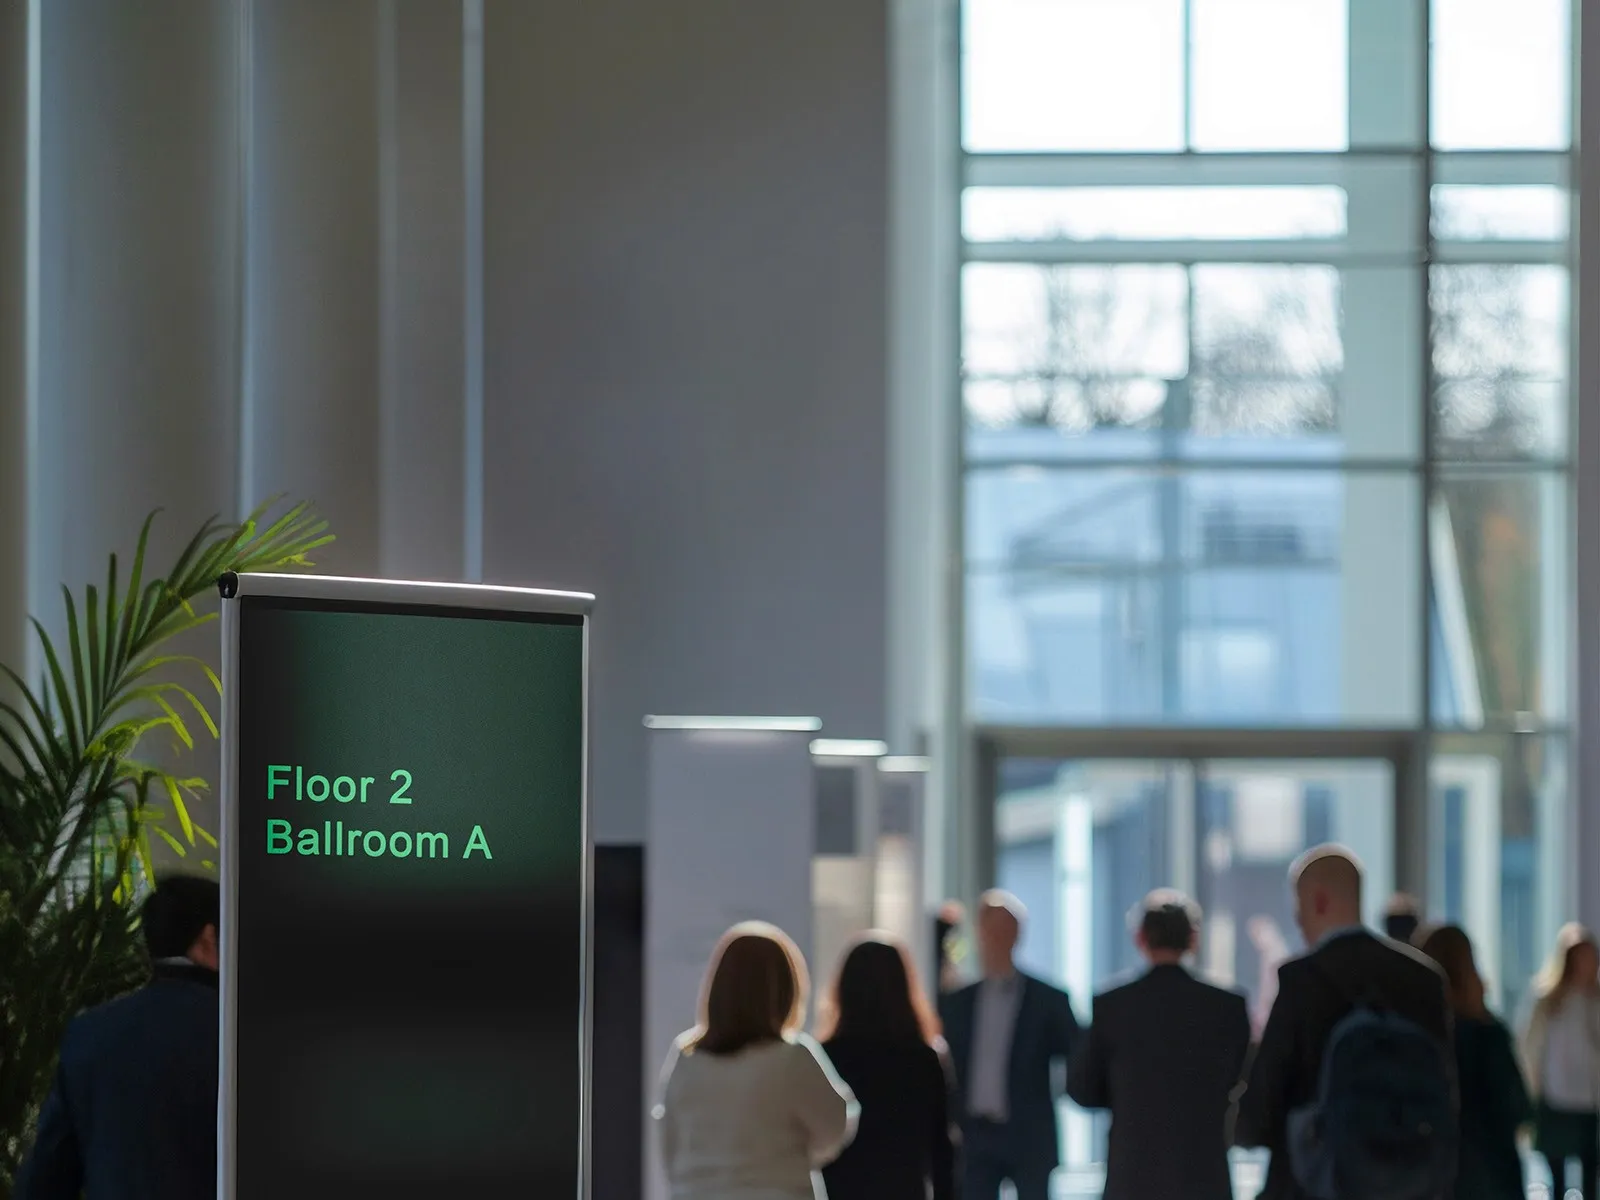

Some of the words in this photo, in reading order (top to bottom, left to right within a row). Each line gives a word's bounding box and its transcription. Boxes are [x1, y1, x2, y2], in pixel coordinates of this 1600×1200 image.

[267, 765, 375, 803] Floor
[389, 769, 413, 804] 2
[267, 819, 449, 858] Ballroom
[462, 825, 493, 859] A
